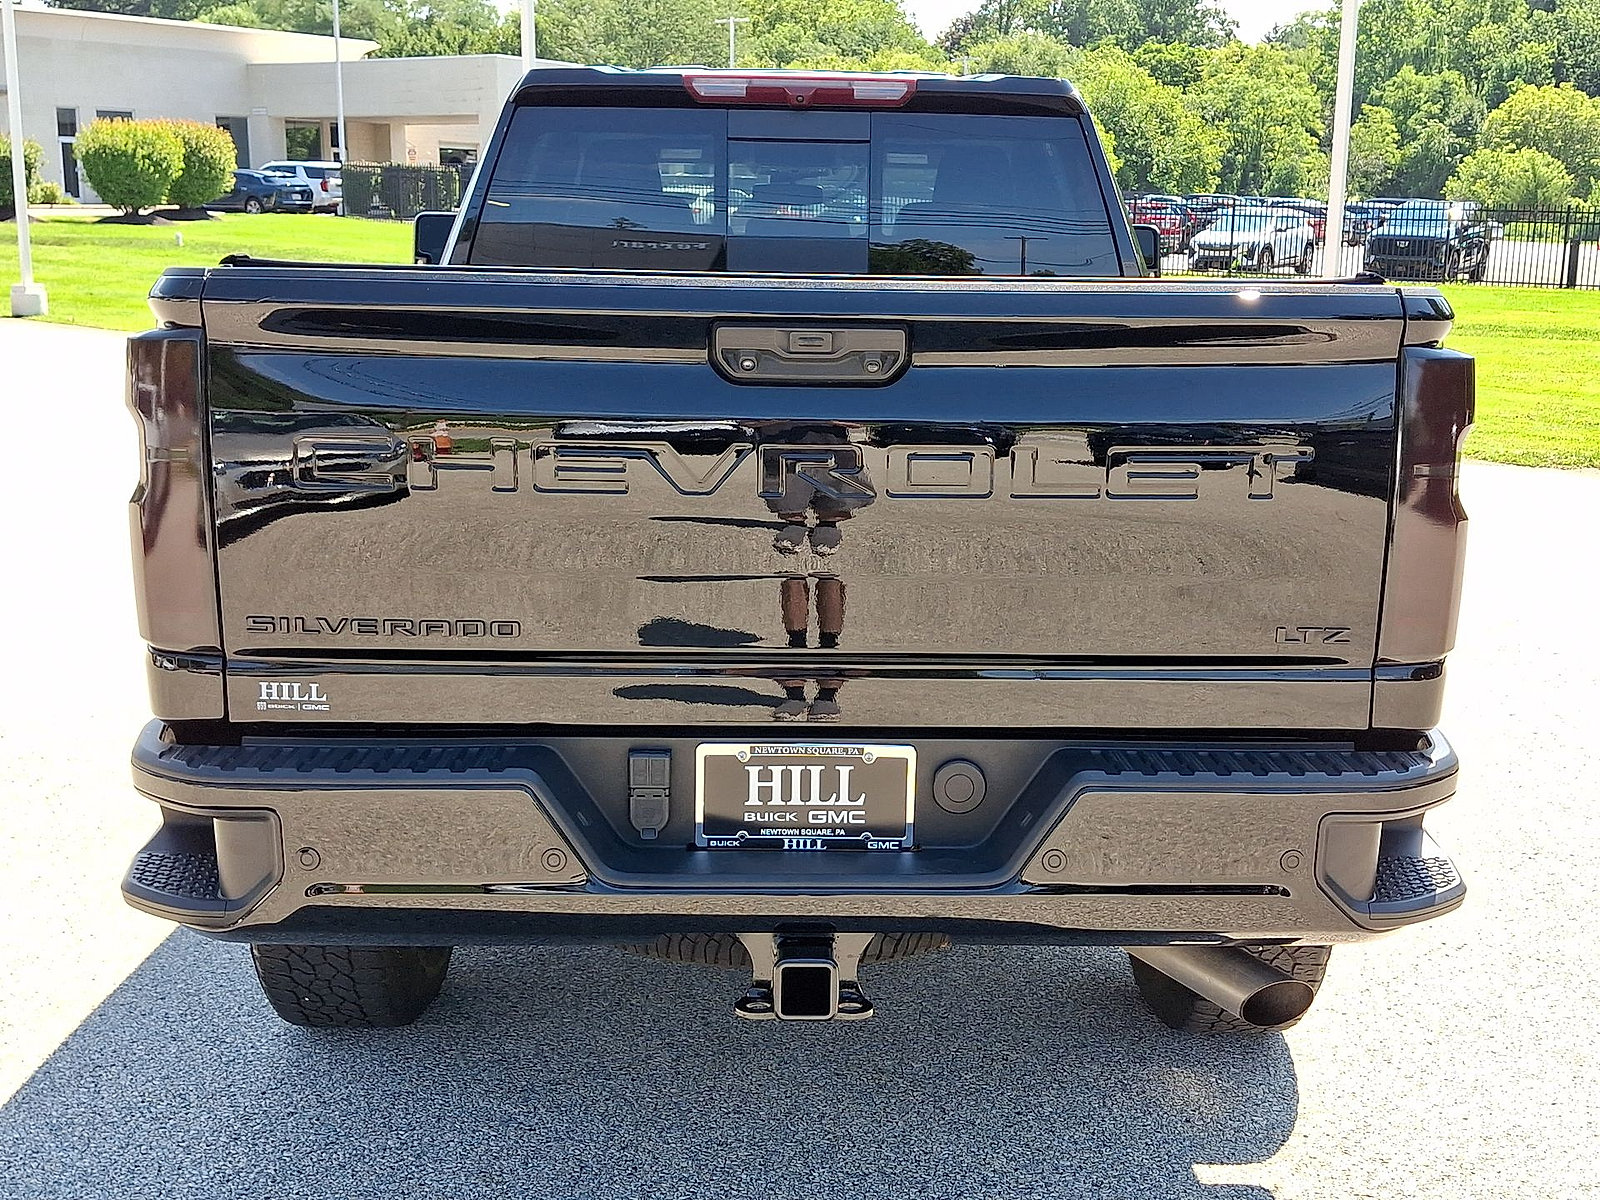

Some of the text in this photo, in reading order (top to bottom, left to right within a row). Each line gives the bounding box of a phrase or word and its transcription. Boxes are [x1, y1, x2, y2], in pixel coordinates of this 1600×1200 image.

[292, 432, 1315, 500] CHEVROLET
[246, 615, 522, 638] SILVERADO
[1274, 626, 1351, 644] LTZ
[258, 682, 327, 702] HILL
[302, 703, 330, 711] GMC
[754, 746, 860, 757] NEWTOWN SQUARE, PA
[744, 765, 866, 806] HILL
[743, 810, 866, 824] BUICK GMC
[760, 828, 846, 837] NEWTOWN SQUARE, PA
[782, 838, 827, 850] HILL
[867, 841, 900, 850] GMC
